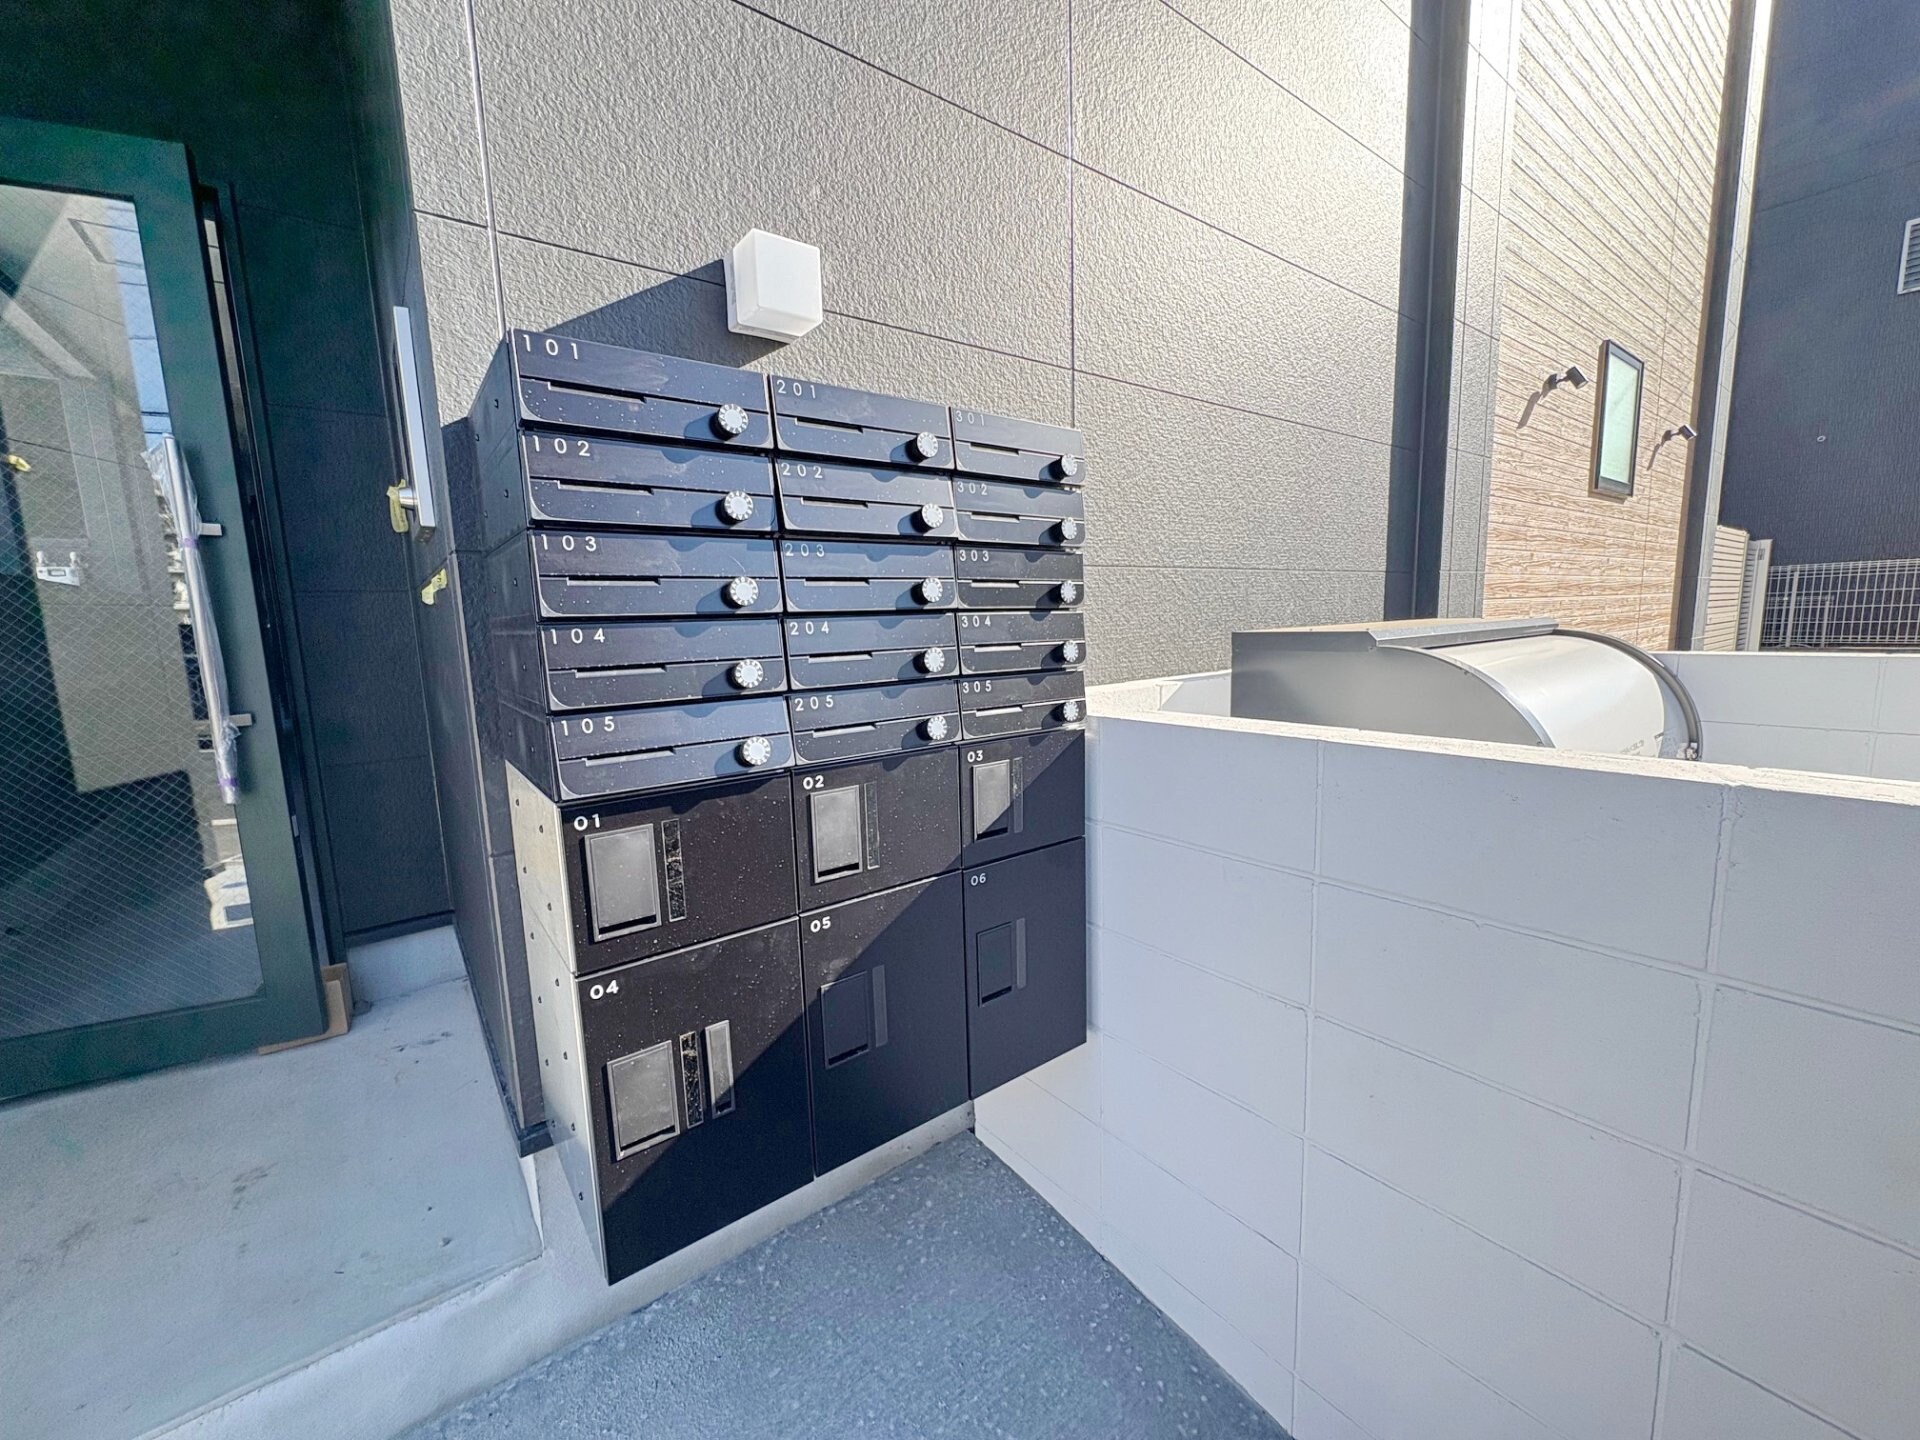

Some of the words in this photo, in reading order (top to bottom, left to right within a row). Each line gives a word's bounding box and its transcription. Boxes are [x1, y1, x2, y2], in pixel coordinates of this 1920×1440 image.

[523, 335, 578, 359] 101
[777, 380, 817, 399] 201
[956, 411, 985, 426] 301
[532, 435, 590, 457] 102
[781, 464, 822, 478] 202
[958, 482, 988, 496] 302
[541, 534, 597, 551] 103
[785, 543, 824, 557] 203
[959, 550, 989, 562] 303
[790, 622, 829, 635] 204
[962, 616, 991, 628] 304
[550, 628, 605, 644] 104
[963, 681, 992, 692] 305
[795, 695, 834, 710] 205
[560, 717, 615, 736] 105
[967, 751, 983, 761] 03
[803, 776, 824, 789] 02
[574, 814, 600, 830] 01
[971, 873, 986, 885] 06
[811, 917, 831, 932] 05
[590, 980, 619, 999] 04
